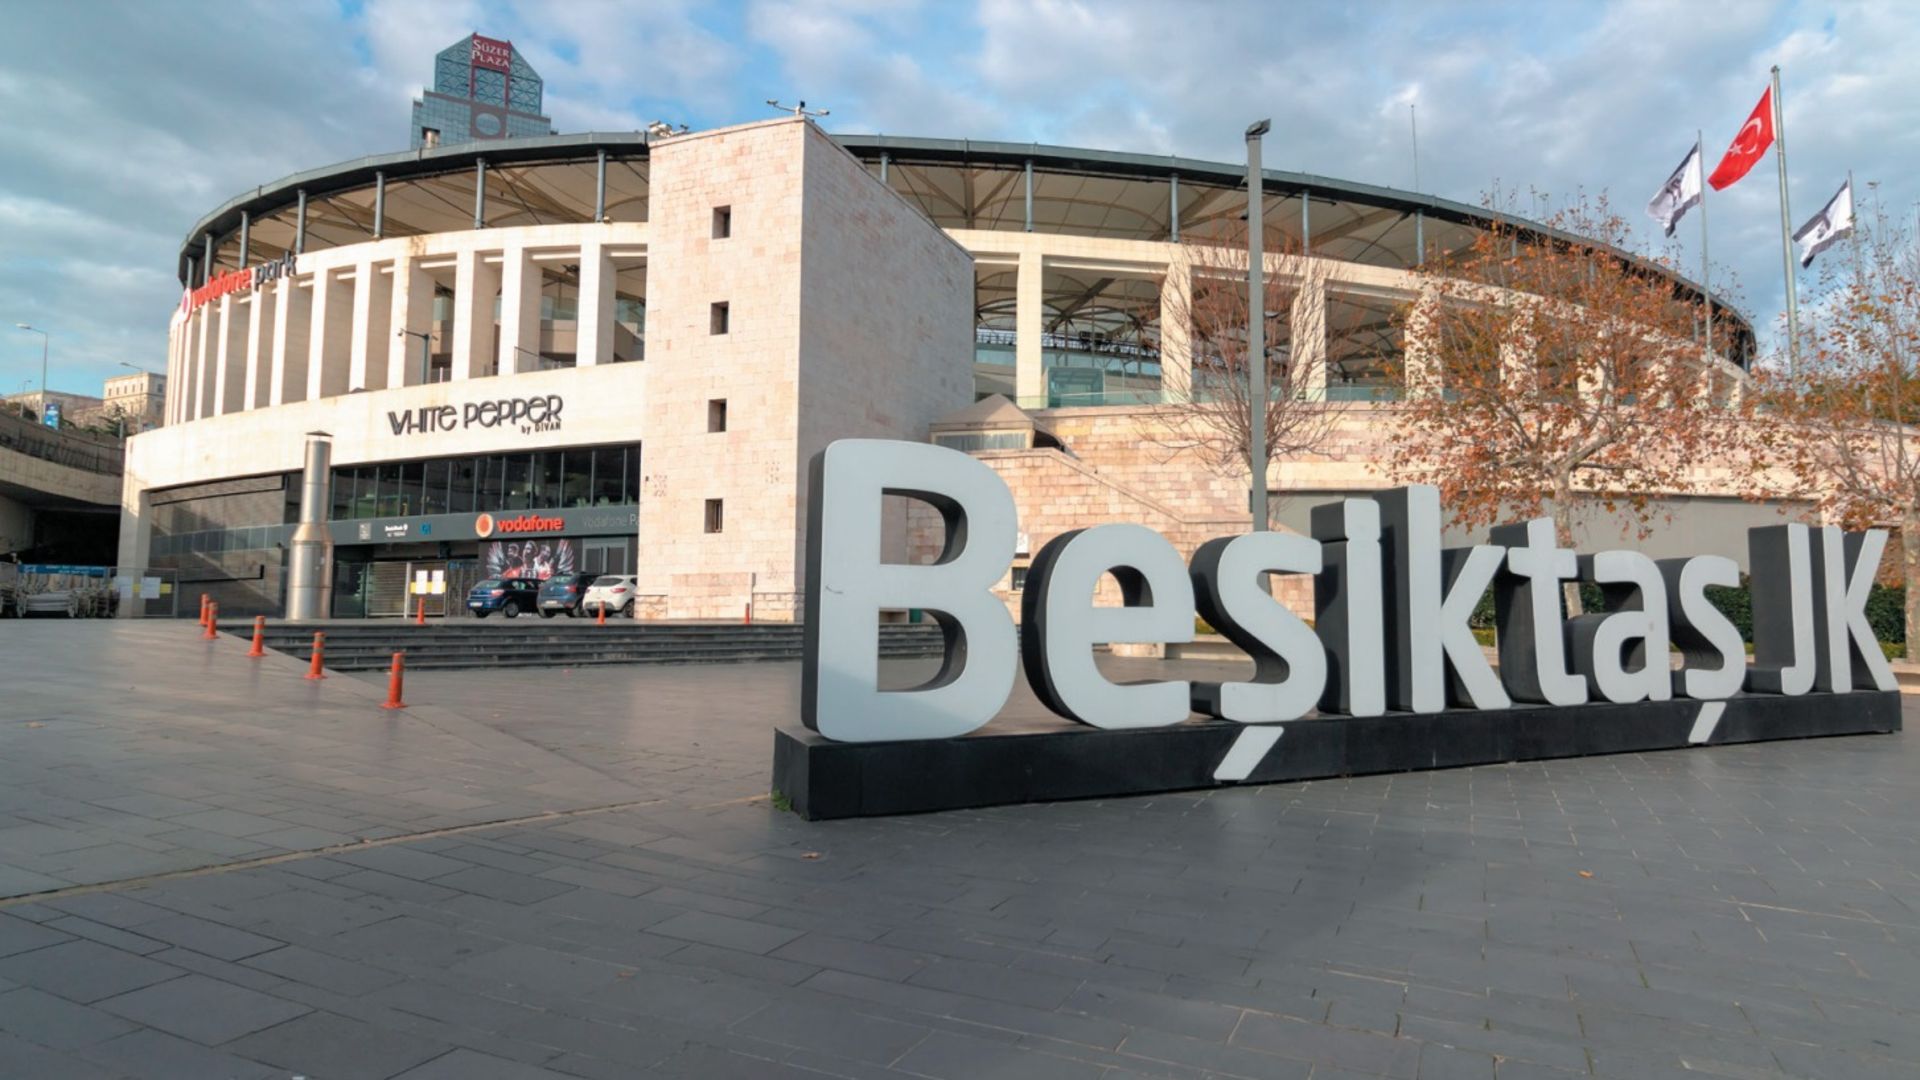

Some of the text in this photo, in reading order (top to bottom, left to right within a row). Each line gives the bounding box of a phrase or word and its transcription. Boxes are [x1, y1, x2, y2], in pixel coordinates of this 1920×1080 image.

[473, 39, 510, 58] SÜZER
[471, 49, 510, 68] PLAZA
[192, 250, 297, 306] vodafone park
[521, 420, 562, 436] by DIVAN
[497, 514, 565, 533] vodafone
[806, 437, 1899, 784] Beşiktaş JK
